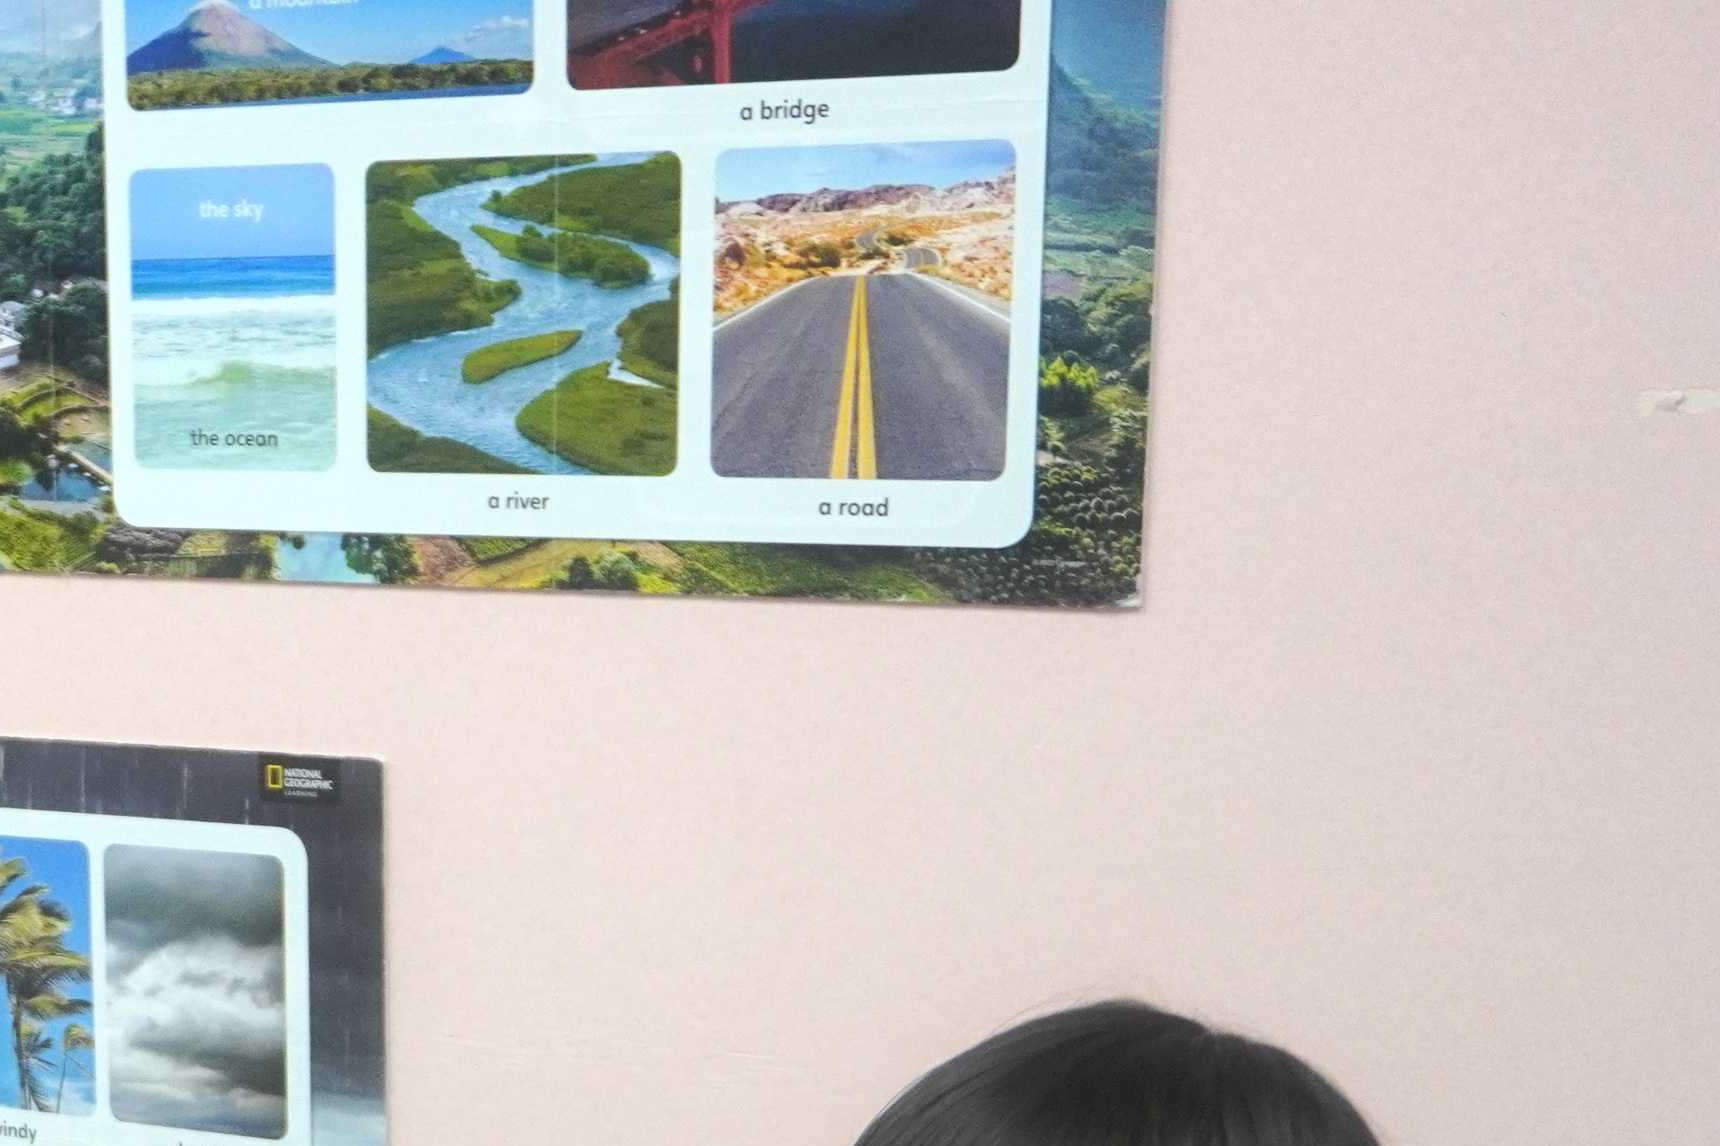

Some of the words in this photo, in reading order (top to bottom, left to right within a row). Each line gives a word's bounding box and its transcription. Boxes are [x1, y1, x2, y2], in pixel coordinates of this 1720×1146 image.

[740, 106, 752, 120] a
[760, 98, 829, 125] bridge
[199, 199, 229, 218] the
[233, 197, 264, 223] sky
[191, 428, 219, 446] the
[225, 434, 278, 447] ocean
[488, 495, 500, 509] a
[506, 490, 550, 510] river
[819, 501, 831, 516] a
[839, 496, 889, 517] road
[283, 767, 324, 780] NATIONAL
[283, 778, 335, 791] GEOGRAPHIC
